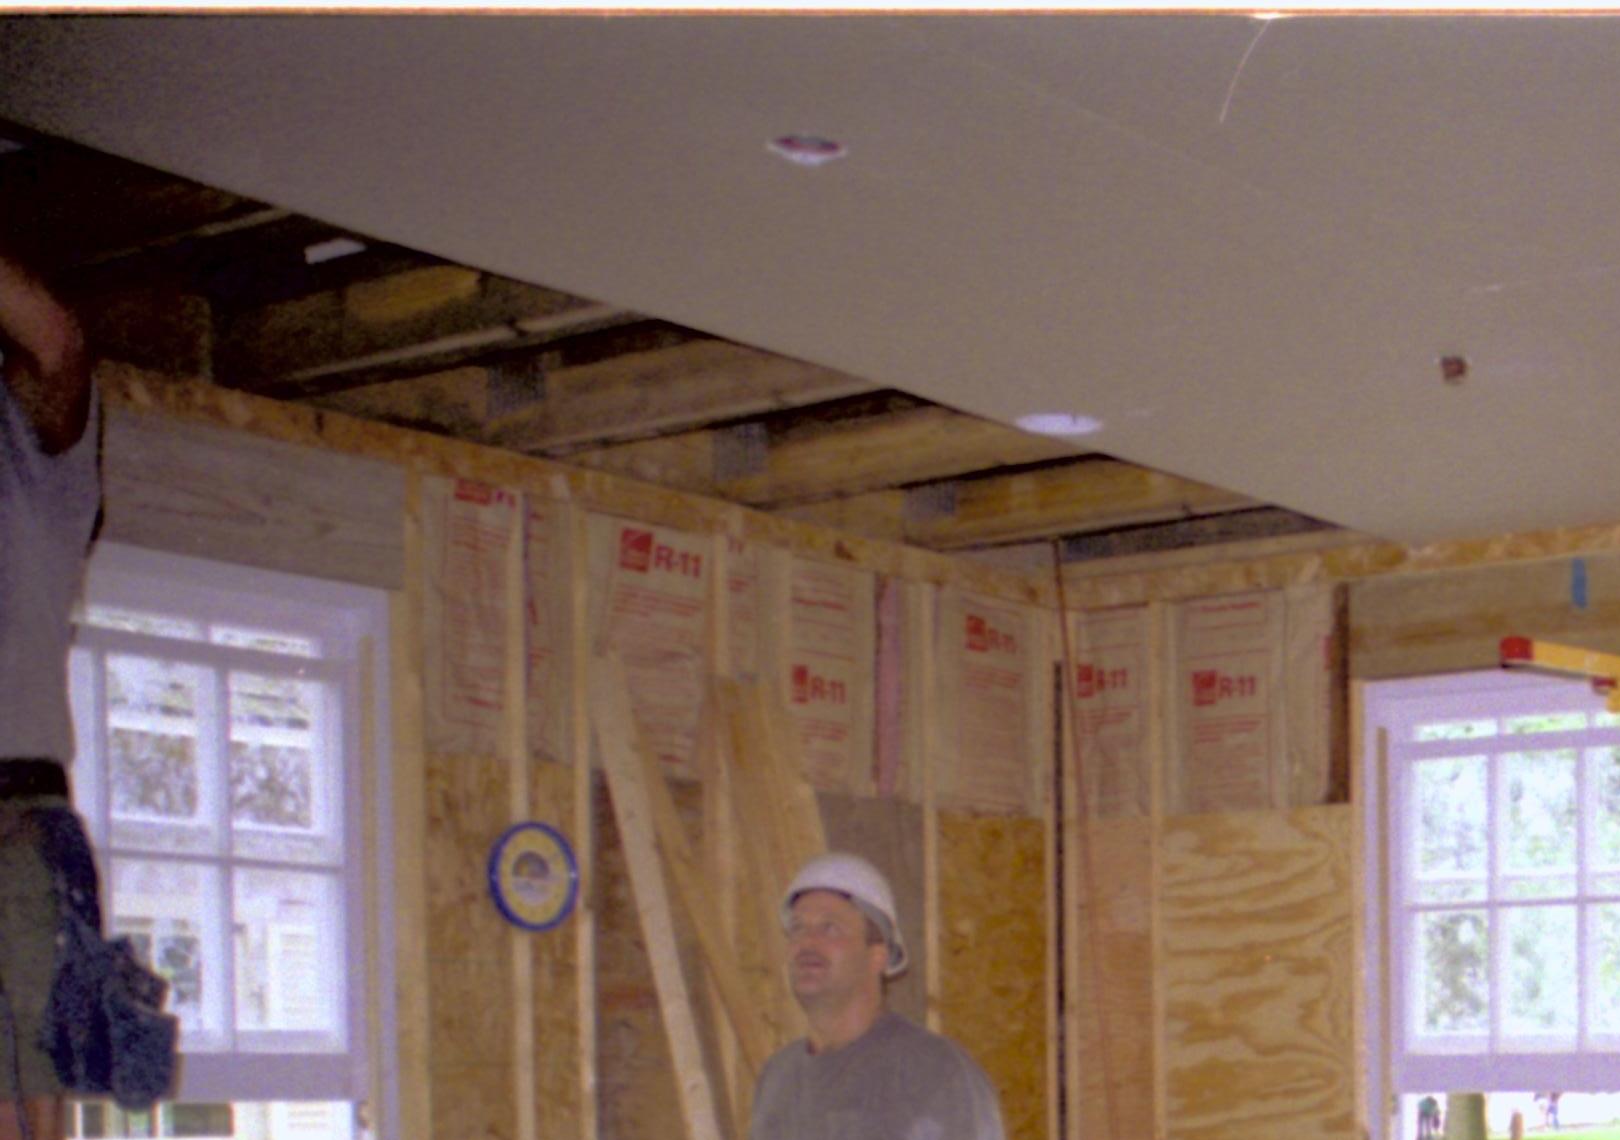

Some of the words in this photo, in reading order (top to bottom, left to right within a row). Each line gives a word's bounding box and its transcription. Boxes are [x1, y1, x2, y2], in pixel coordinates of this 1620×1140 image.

[656, 543, 703, 579] R-11
[810, 675, 847, 706] R-11
[1219, 675, 1257, 698] R-11
